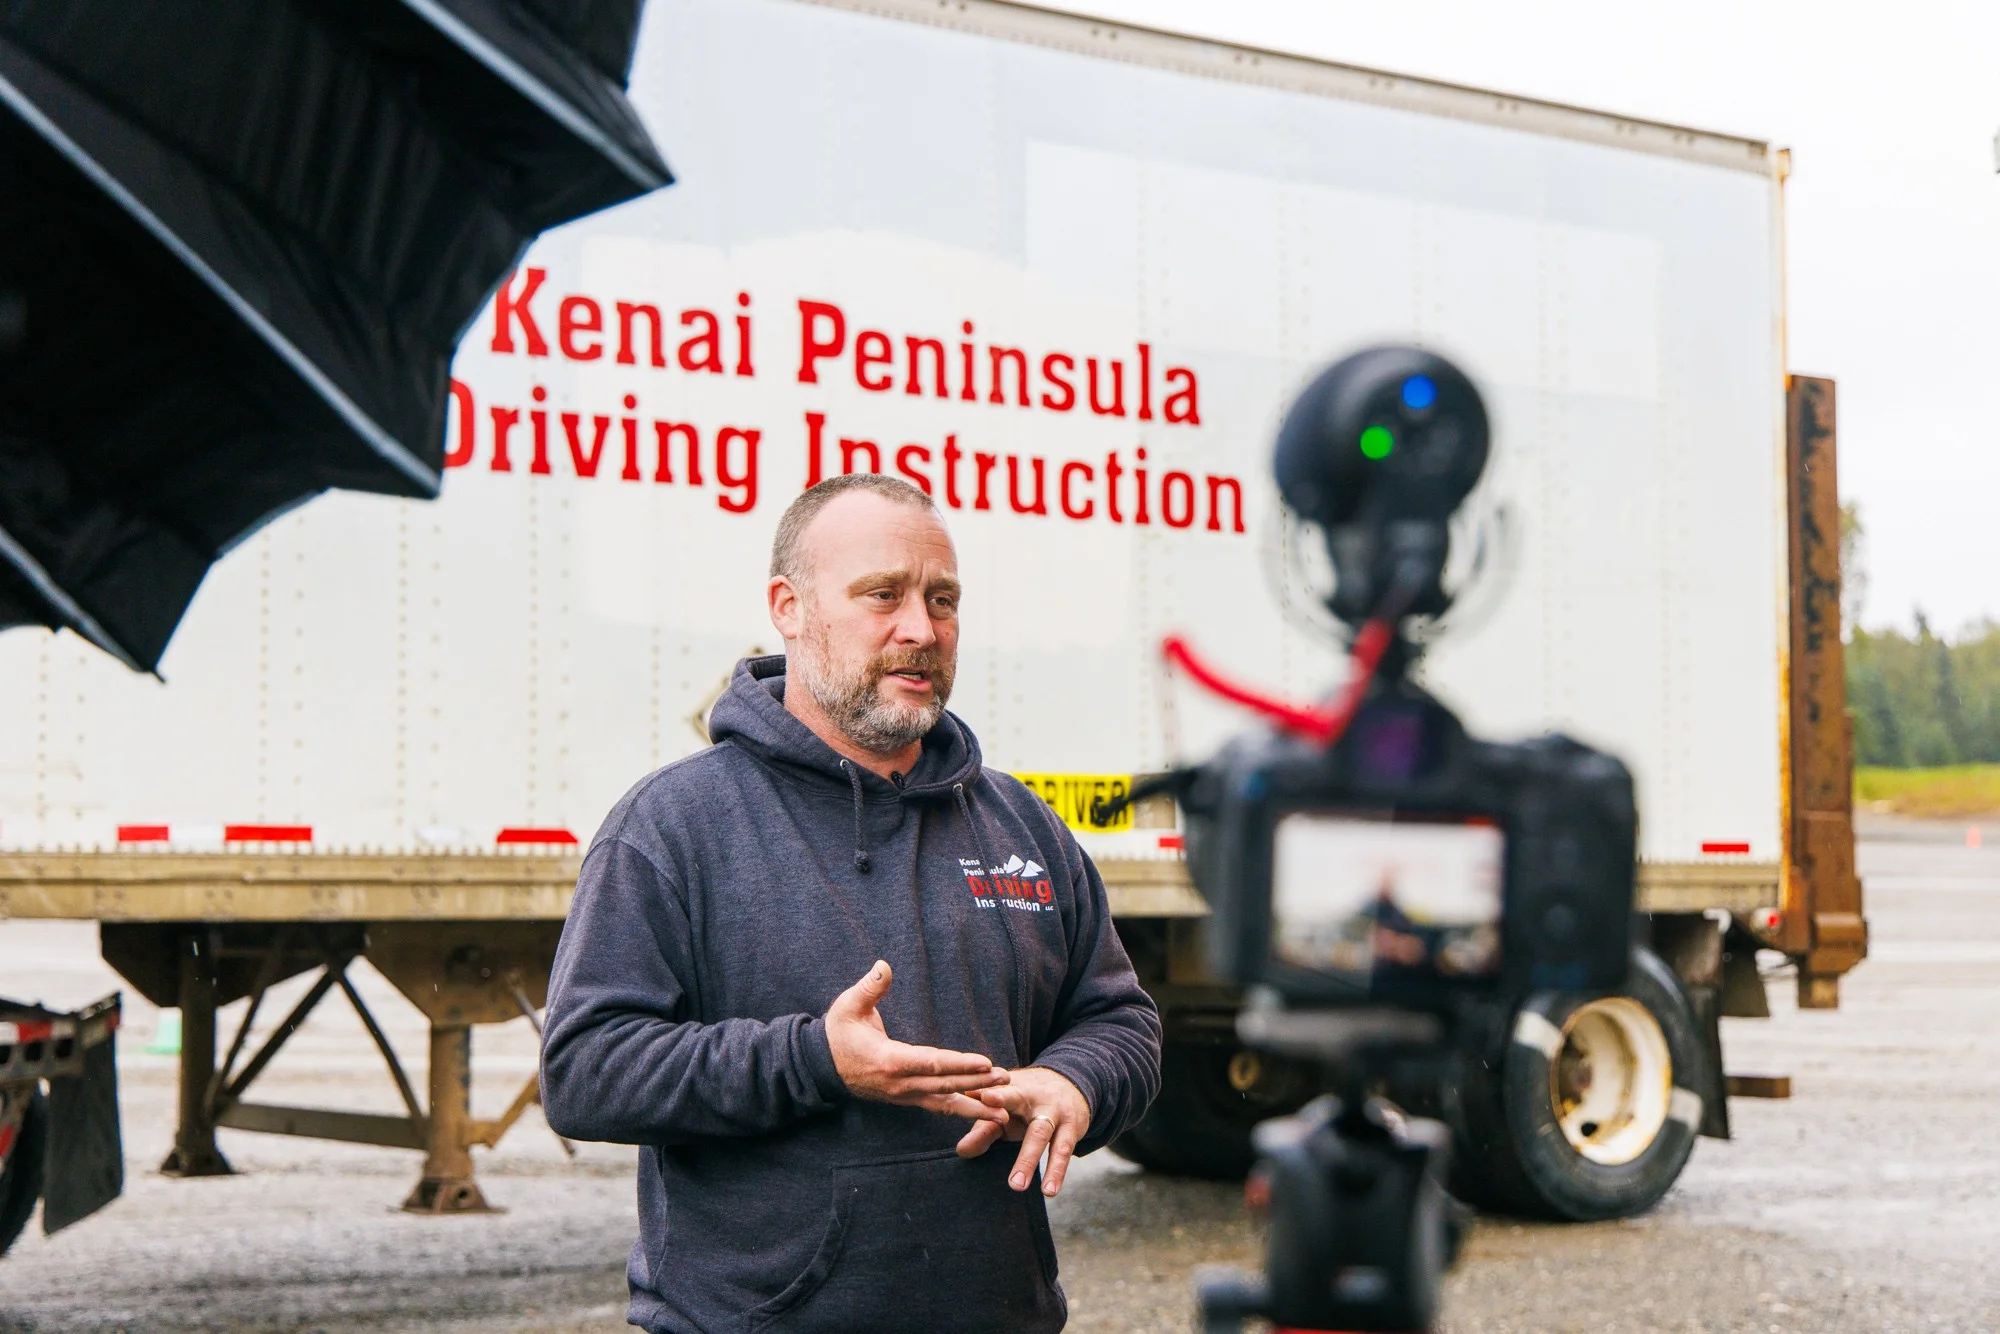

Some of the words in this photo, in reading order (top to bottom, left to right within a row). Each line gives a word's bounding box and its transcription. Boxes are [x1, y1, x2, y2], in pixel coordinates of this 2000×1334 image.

[490, 266, 756, 378] Kenai
[796, 298, 1202, 427] Peninsula
[804, 410, 1246, 534] Instruction
